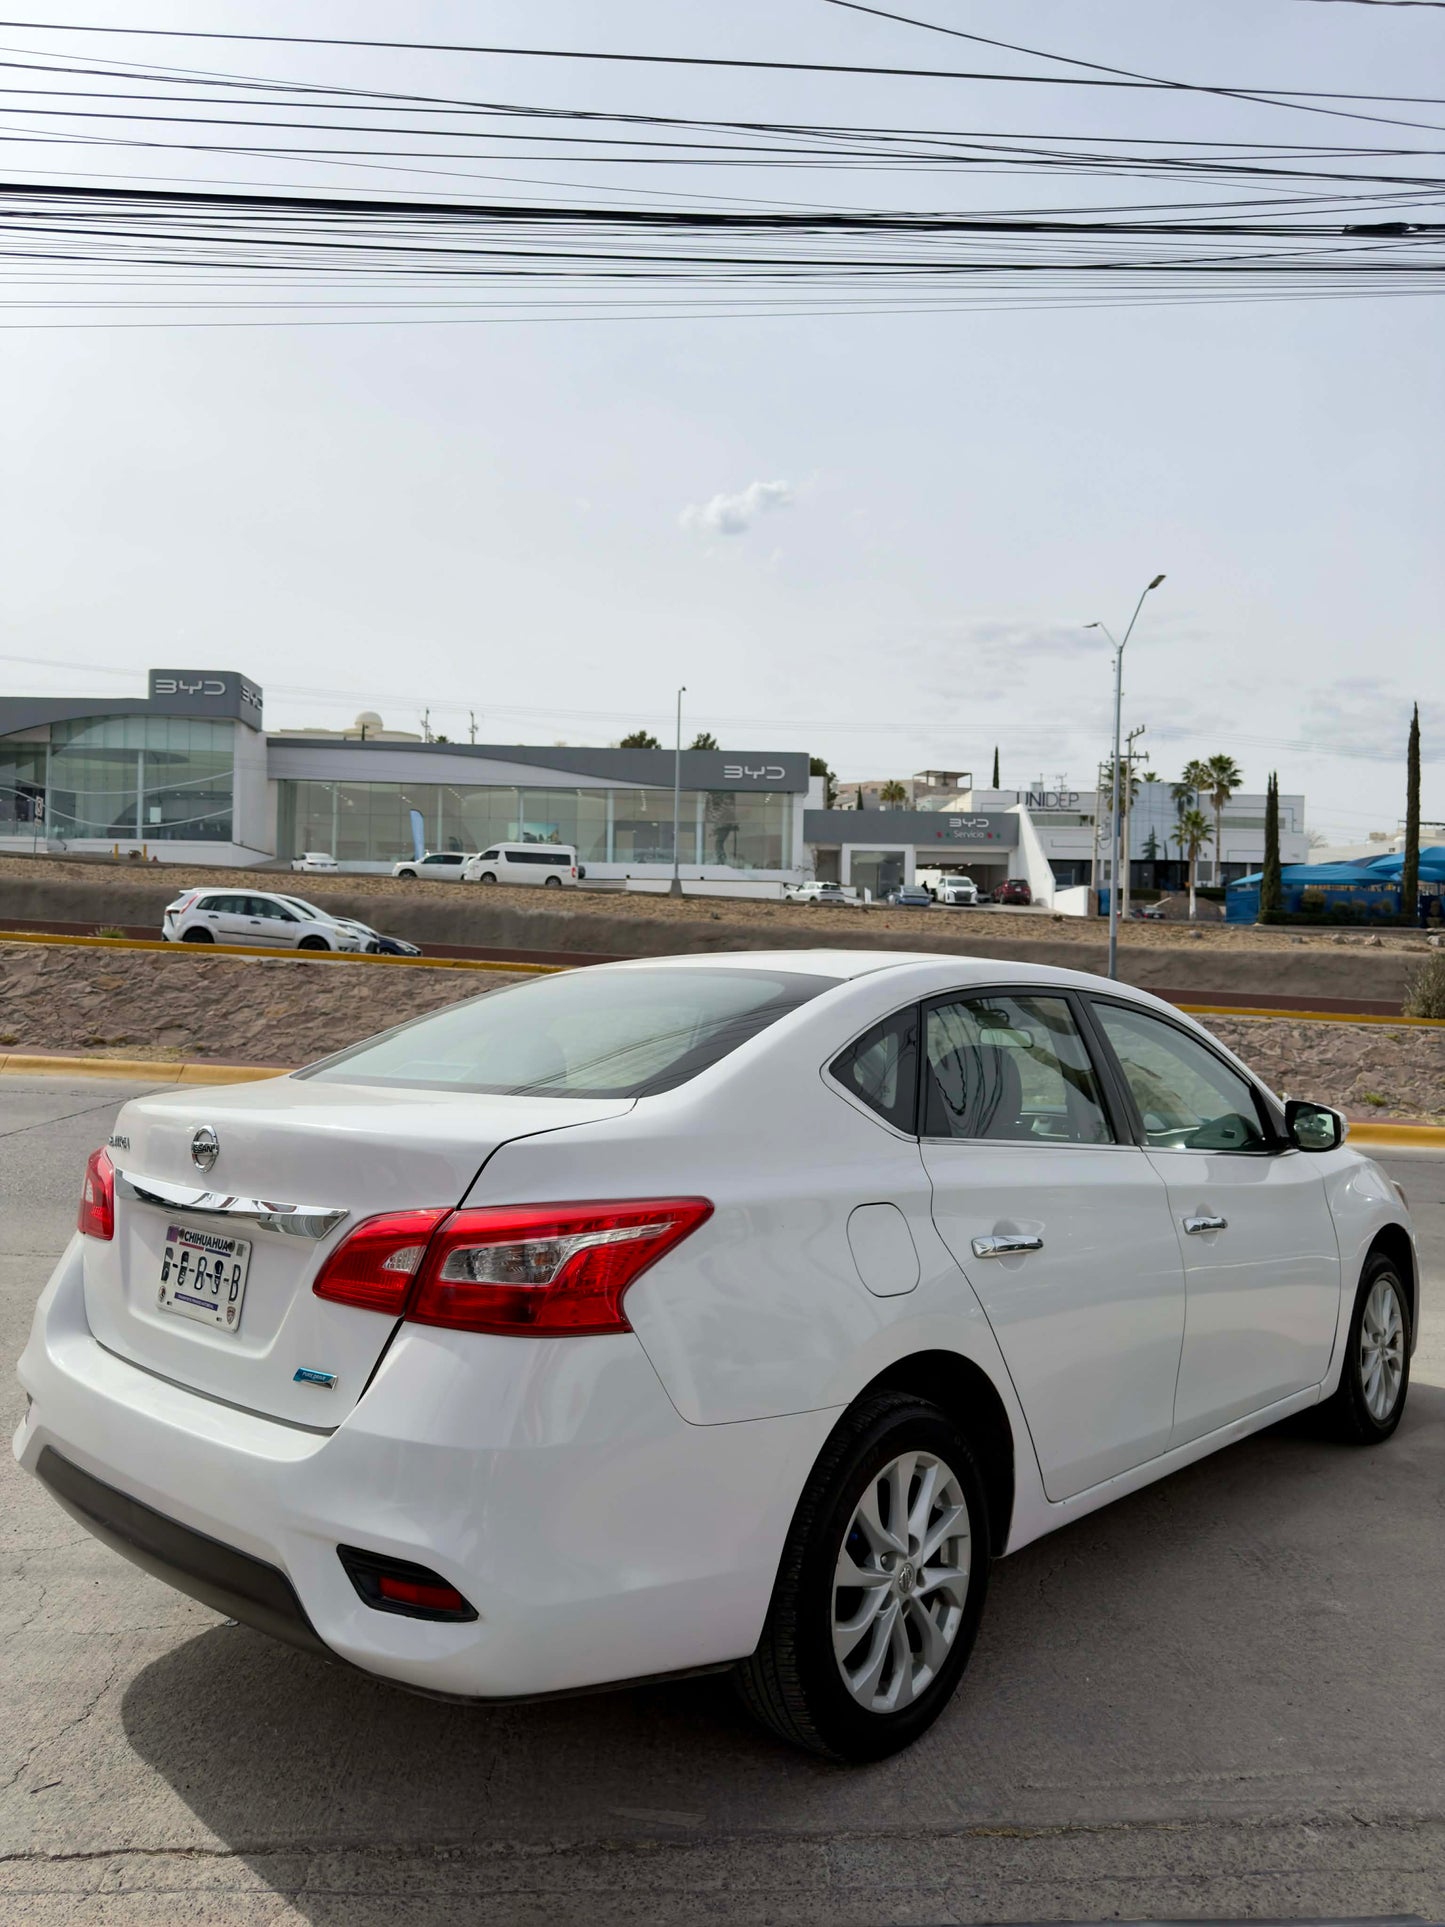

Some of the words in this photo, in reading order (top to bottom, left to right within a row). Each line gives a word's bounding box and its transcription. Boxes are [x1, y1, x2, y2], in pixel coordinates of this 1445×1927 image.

[155, 679, 226, 695] BYD
[723, 765, 786, 780] BYD
[1016, 791, 1080, 808] UNIDEP
[949, 818, 989, 828] BYD
[953, 830, 985, 839] Servicio
[184, 1230, 229, 1252] CHIHUAHUA
